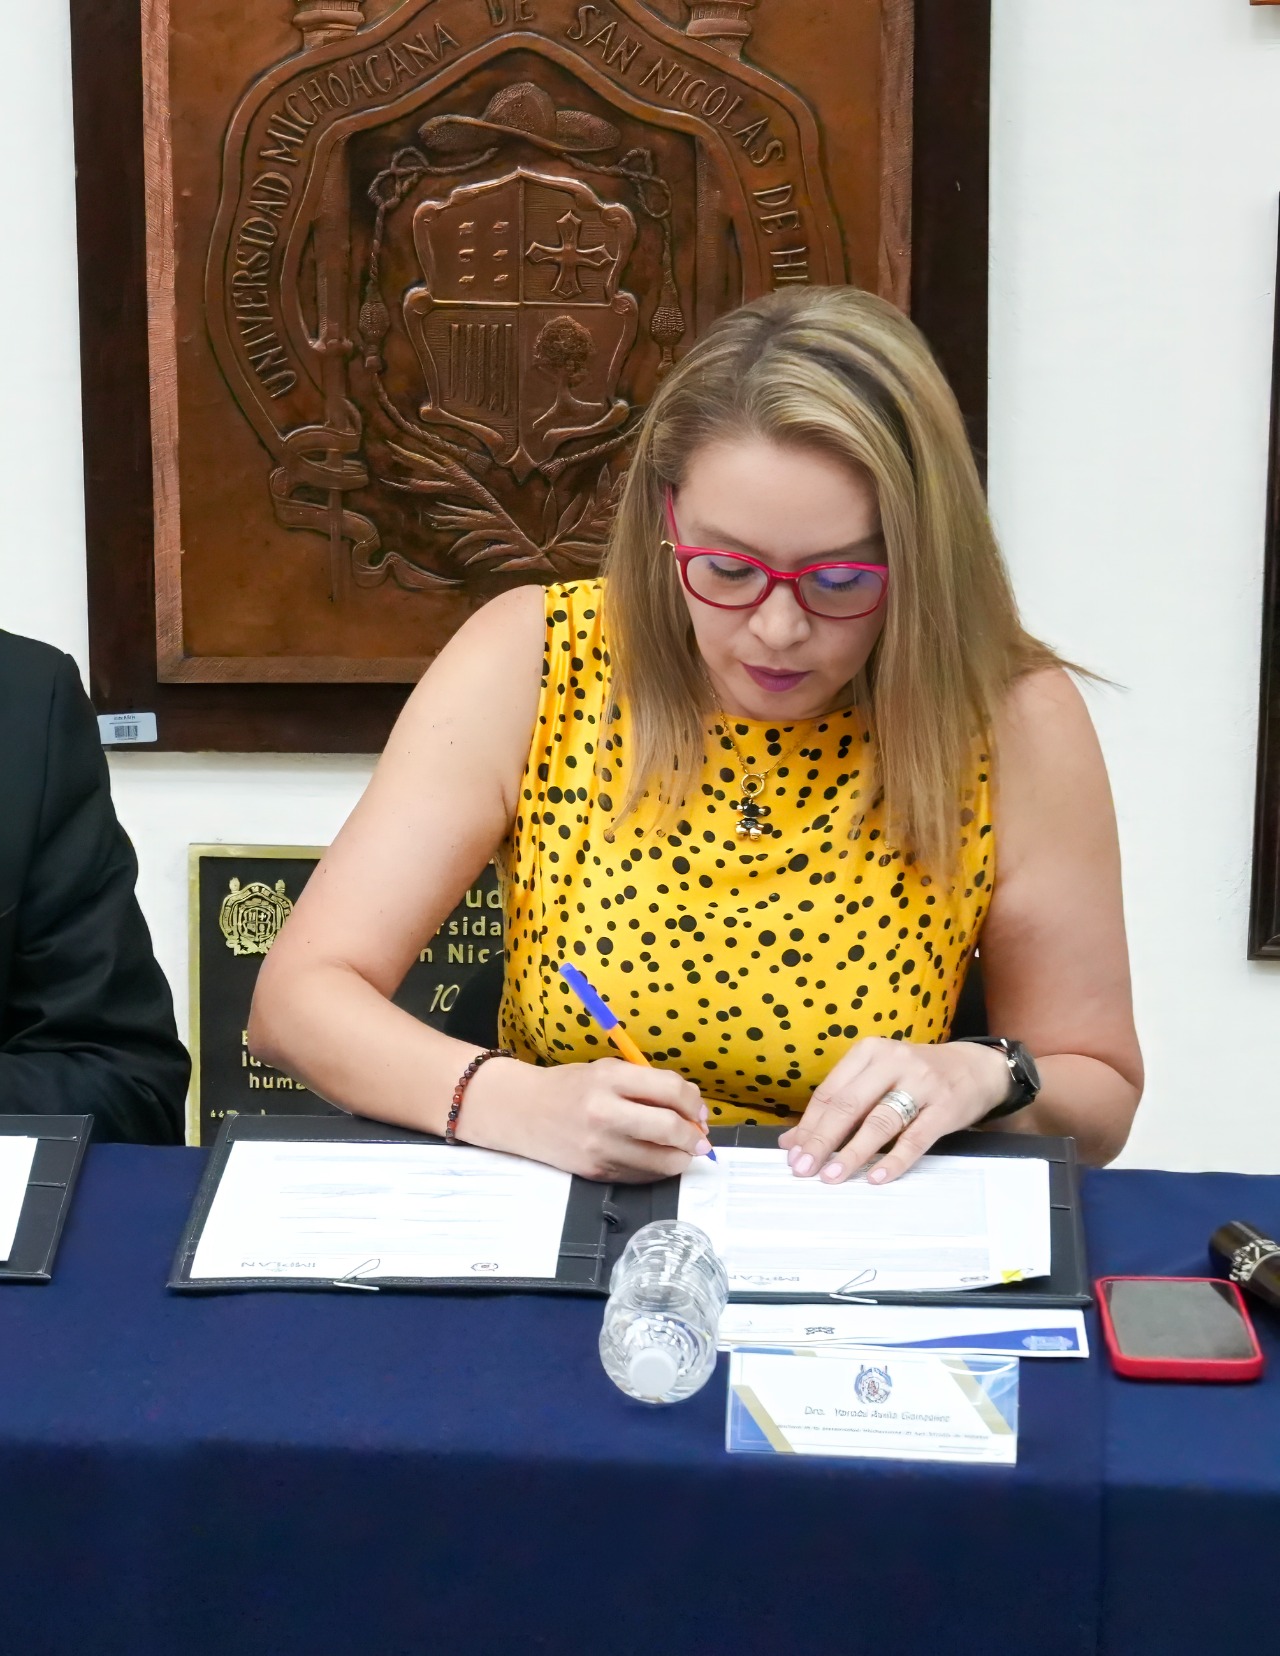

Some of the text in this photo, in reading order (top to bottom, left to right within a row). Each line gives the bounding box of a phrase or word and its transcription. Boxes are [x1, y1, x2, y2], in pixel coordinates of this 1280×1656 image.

[486, 0, 536, 27] DE
[567, 5, 643, 74] SAN
[260, 22, 460, 166] MICHOACANA
[639, 57, 784, 165] NICOLAS
[752, 184, 801, 235] DE
[233, 171, 297, 398] UNIVERSIDAD
[429, 984, 460, 1012] 10
